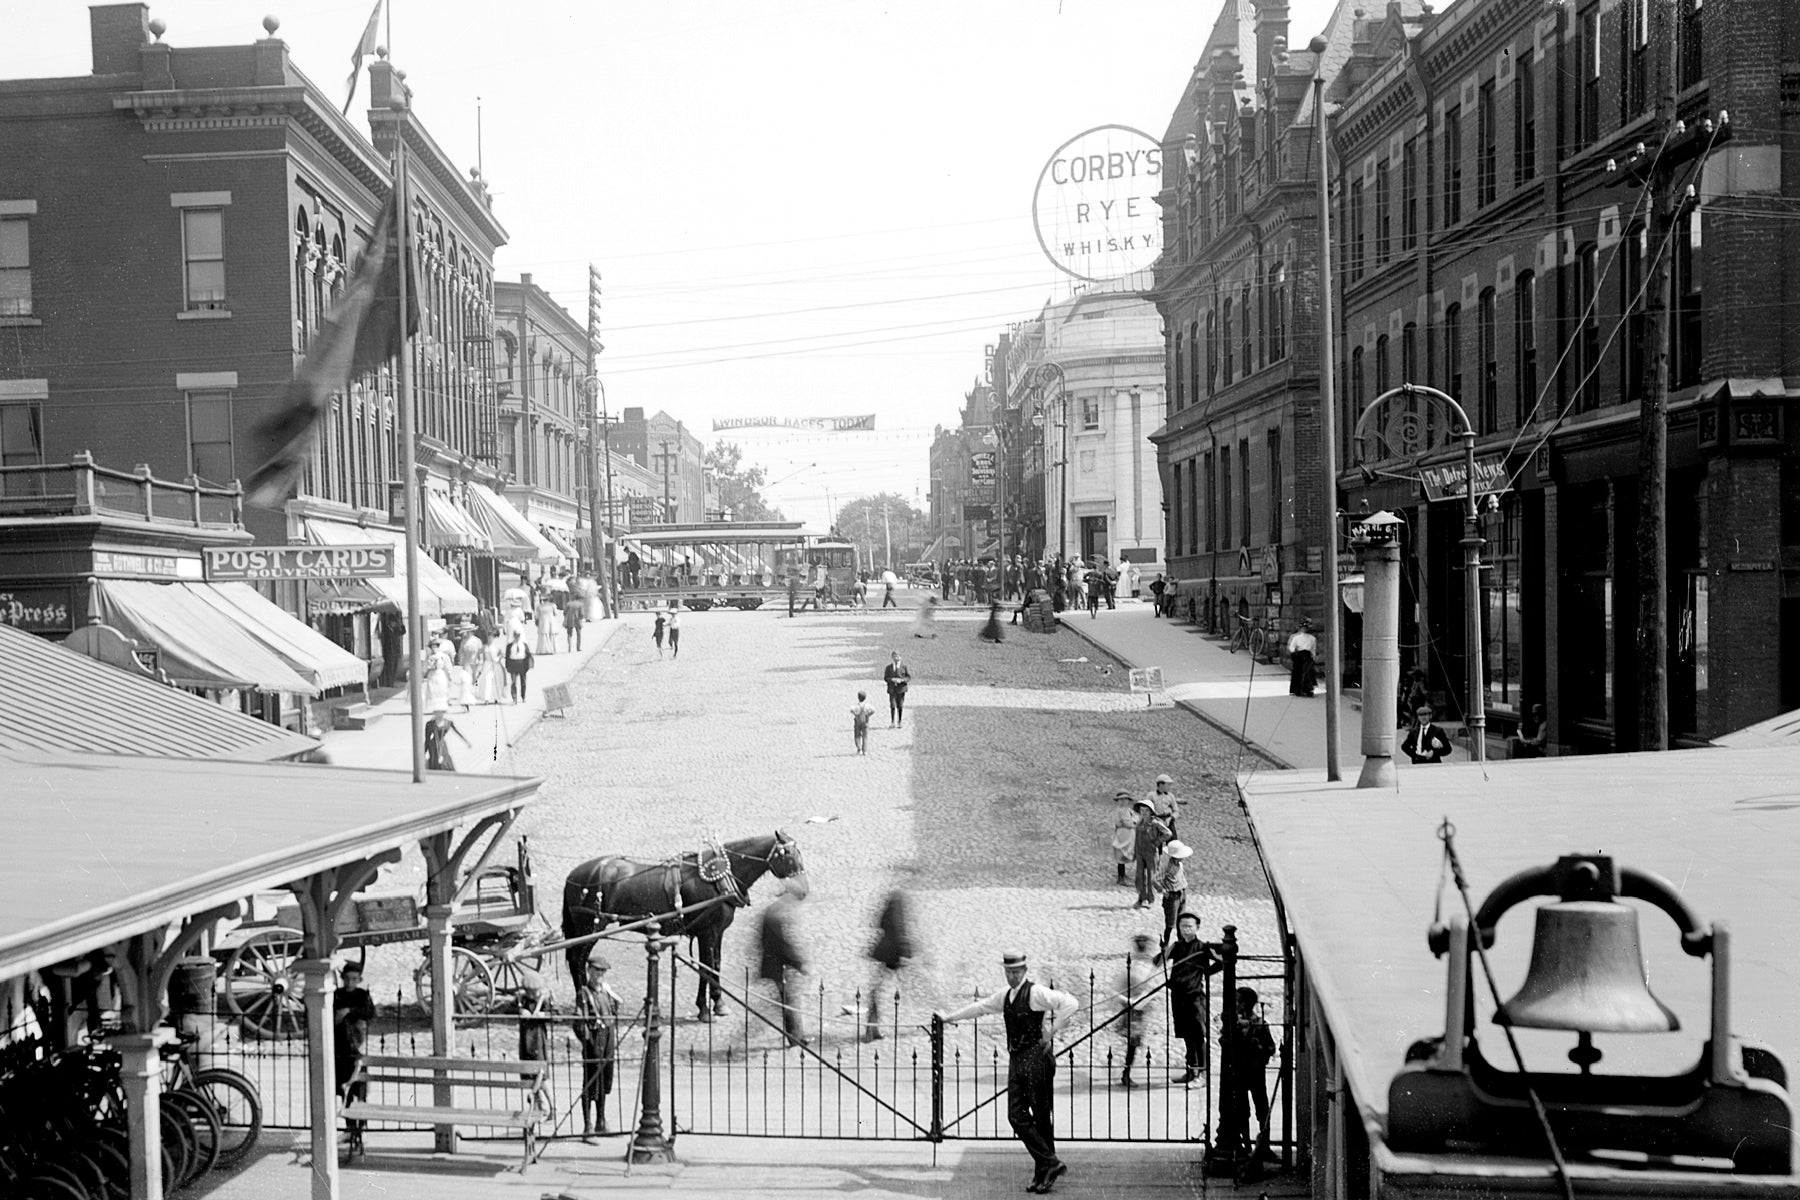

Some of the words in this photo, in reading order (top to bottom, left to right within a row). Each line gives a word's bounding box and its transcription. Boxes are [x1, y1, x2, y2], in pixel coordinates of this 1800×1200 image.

[1051, 149, 1162, 185] CORBY'S
[1077, 197, 1141, 223] RYE
[1064, 234, 1153, 256] WHISKY
[719, 416, 777, 428] WINDSOR
[1425, 470, 1441, 487] The
[1442, 463, 1469, 485] Detroi
[211, 550, 287, 570] POST
[296, 549, 387, 569] CARDS
[247, 568, 351, 578] SOUVENIRS
